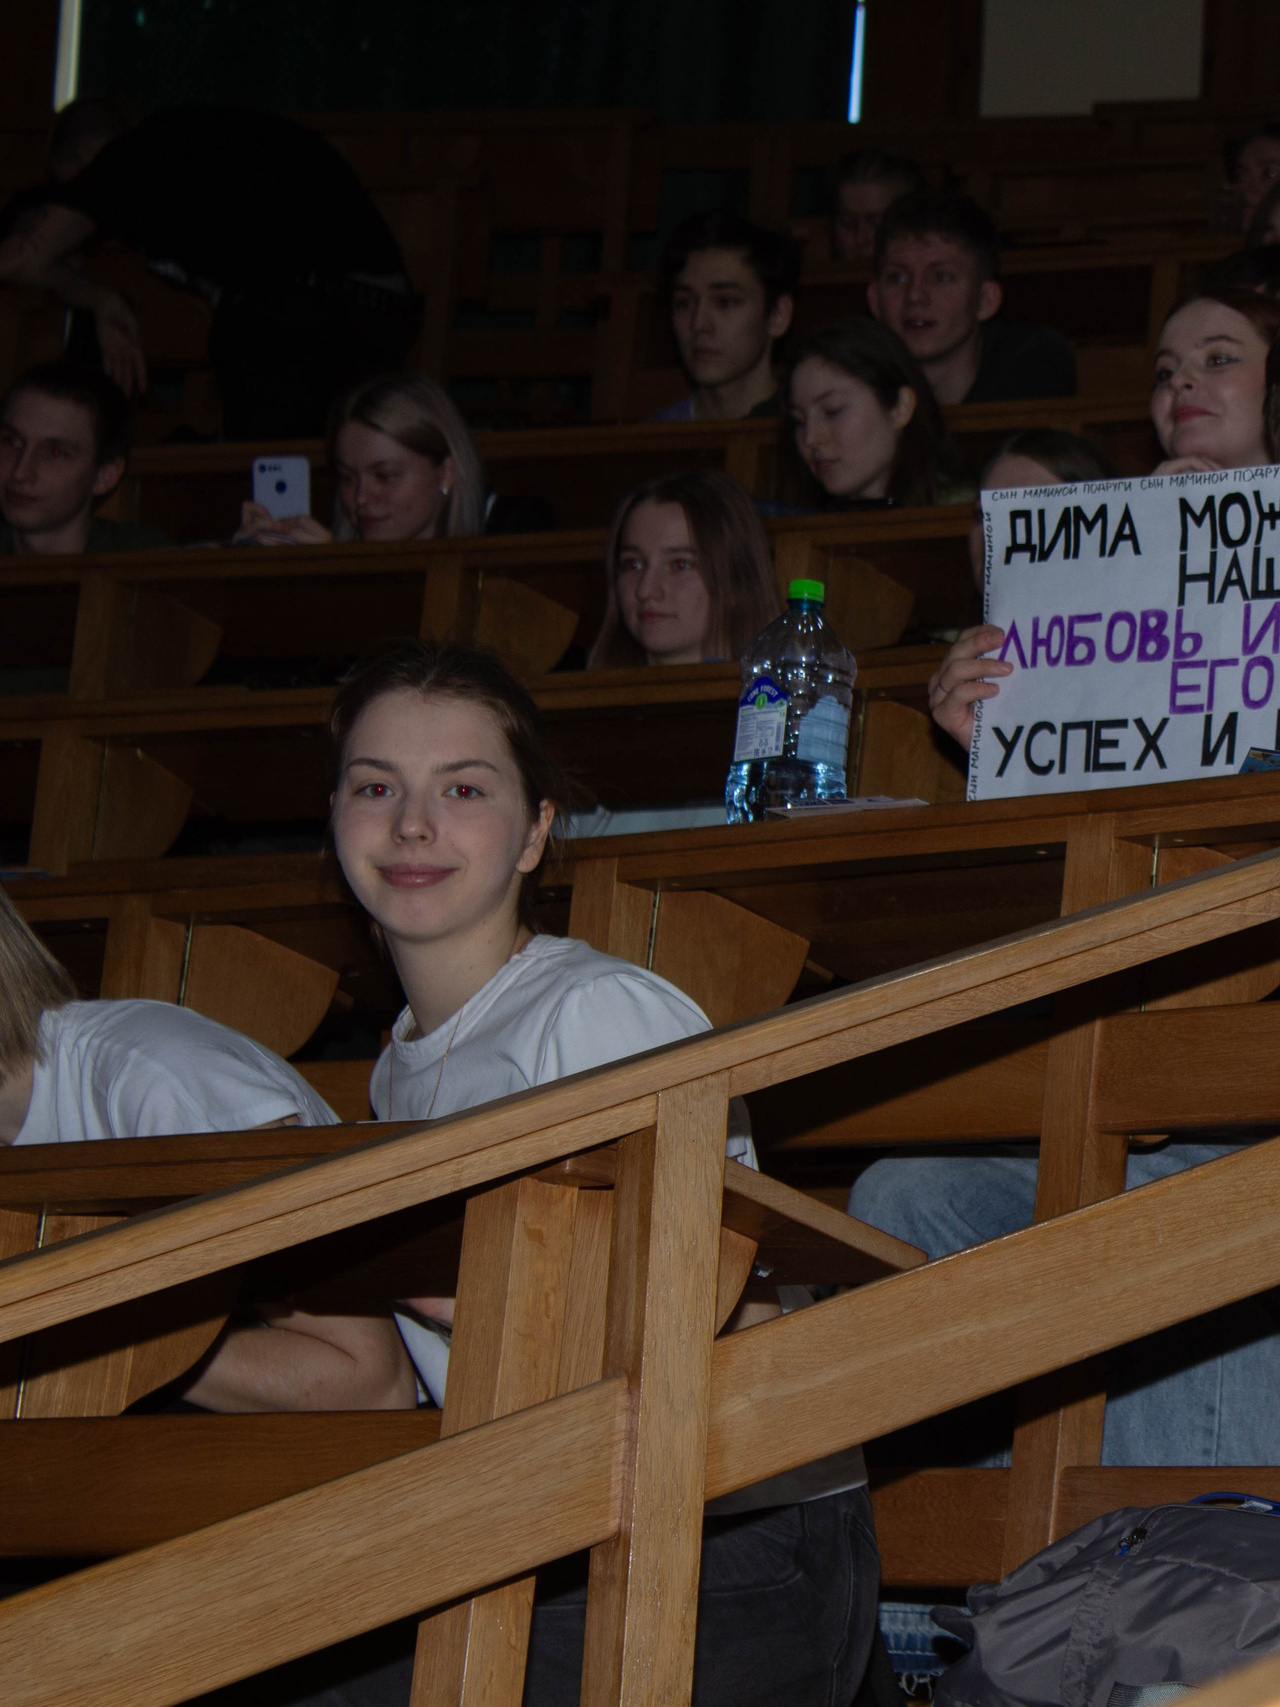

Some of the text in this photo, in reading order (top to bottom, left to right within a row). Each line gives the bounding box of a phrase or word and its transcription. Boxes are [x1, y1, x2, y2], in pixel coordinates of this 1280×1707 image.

[992, 491, 1017, 501] СЫН
[1022, 485, 1078, 499] МАМИНОЙ
[1083, 481, 1132, 494] ПОДРУГИ
[1140, 478, 1163, 490] СЫН
[1170, 471, 1228, 487] МАМИНОЙ
[1003, 503, 1142, 565] ДИМА
[999, 605, 1204, 669] ЛЮБОВЬ
[1169, 655, 1275, 715] ЕГО
[991, 717, 1170, 778] УСПЕХ
[1200, 711, 1238, 767] И
